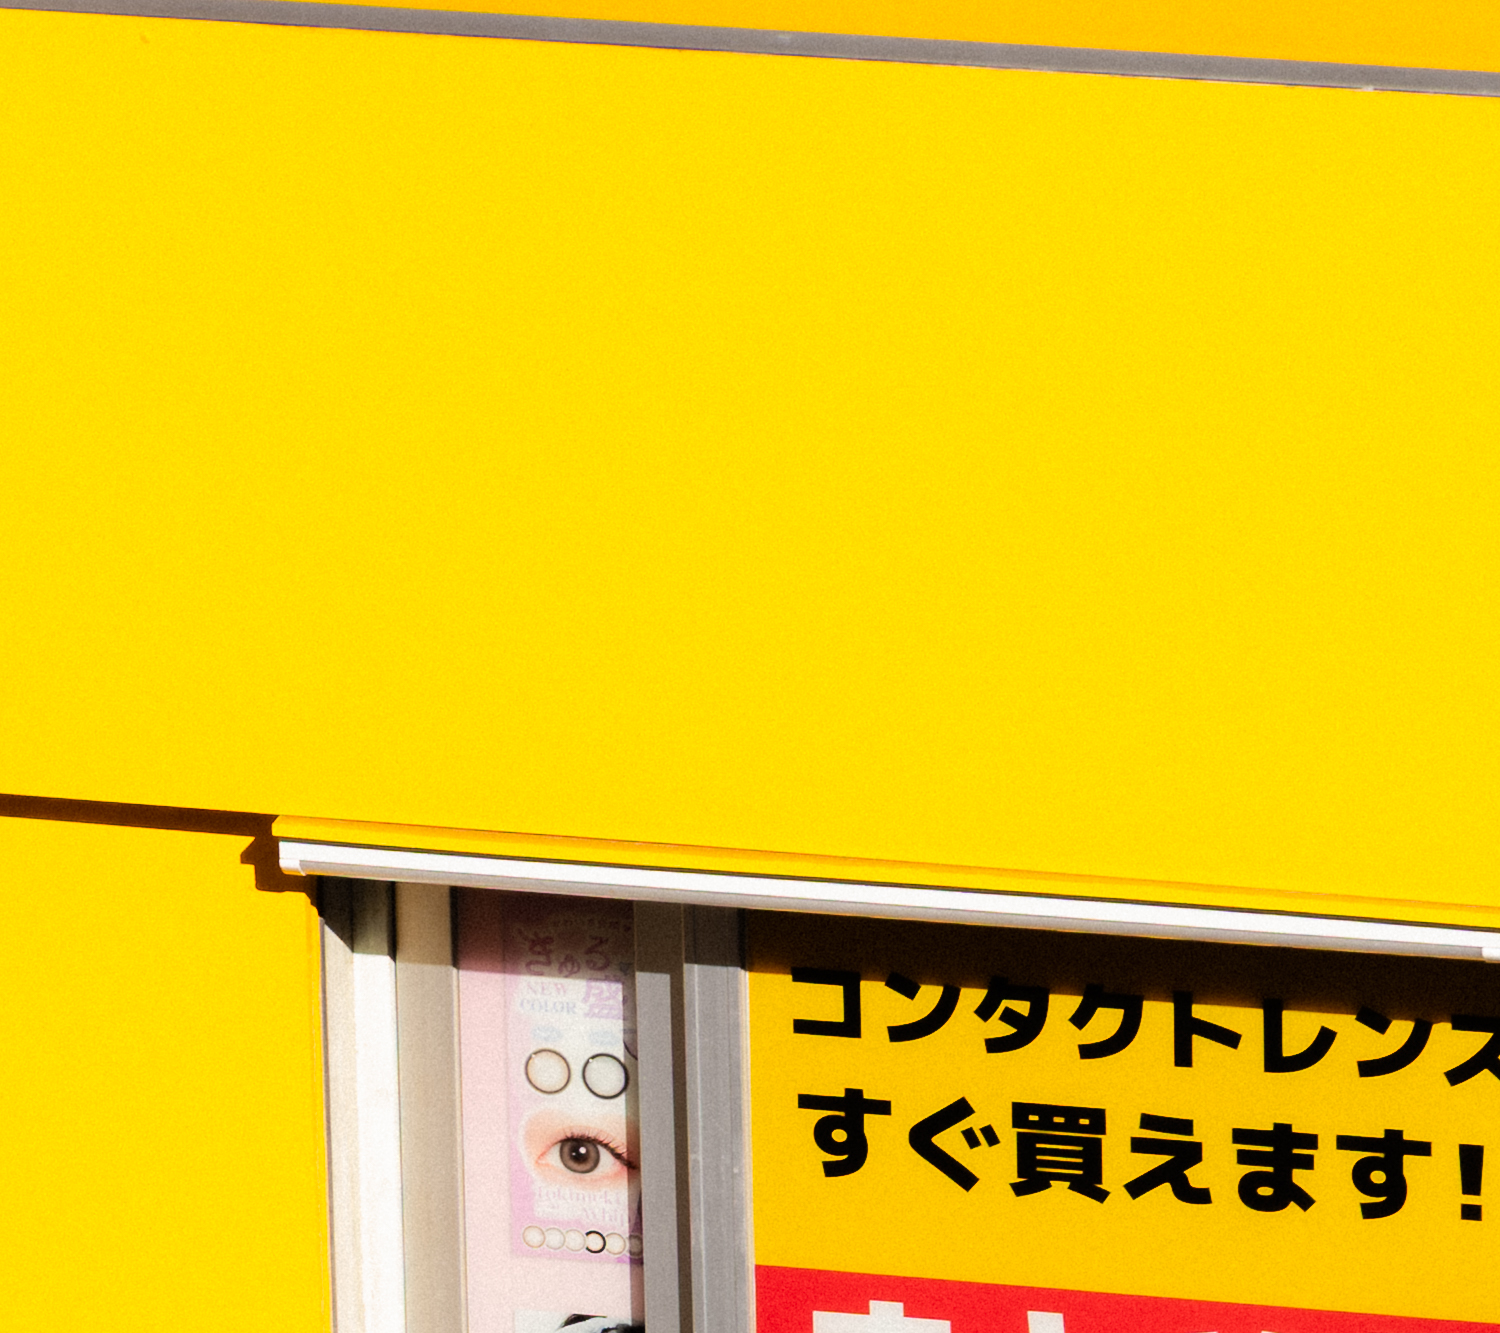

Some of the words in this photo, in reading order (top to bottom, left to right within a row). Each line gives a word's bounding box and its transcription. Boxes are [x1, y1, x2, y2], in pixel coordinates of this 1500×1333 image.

[798, 1088, 1487, 1222] すぐ買えます!
